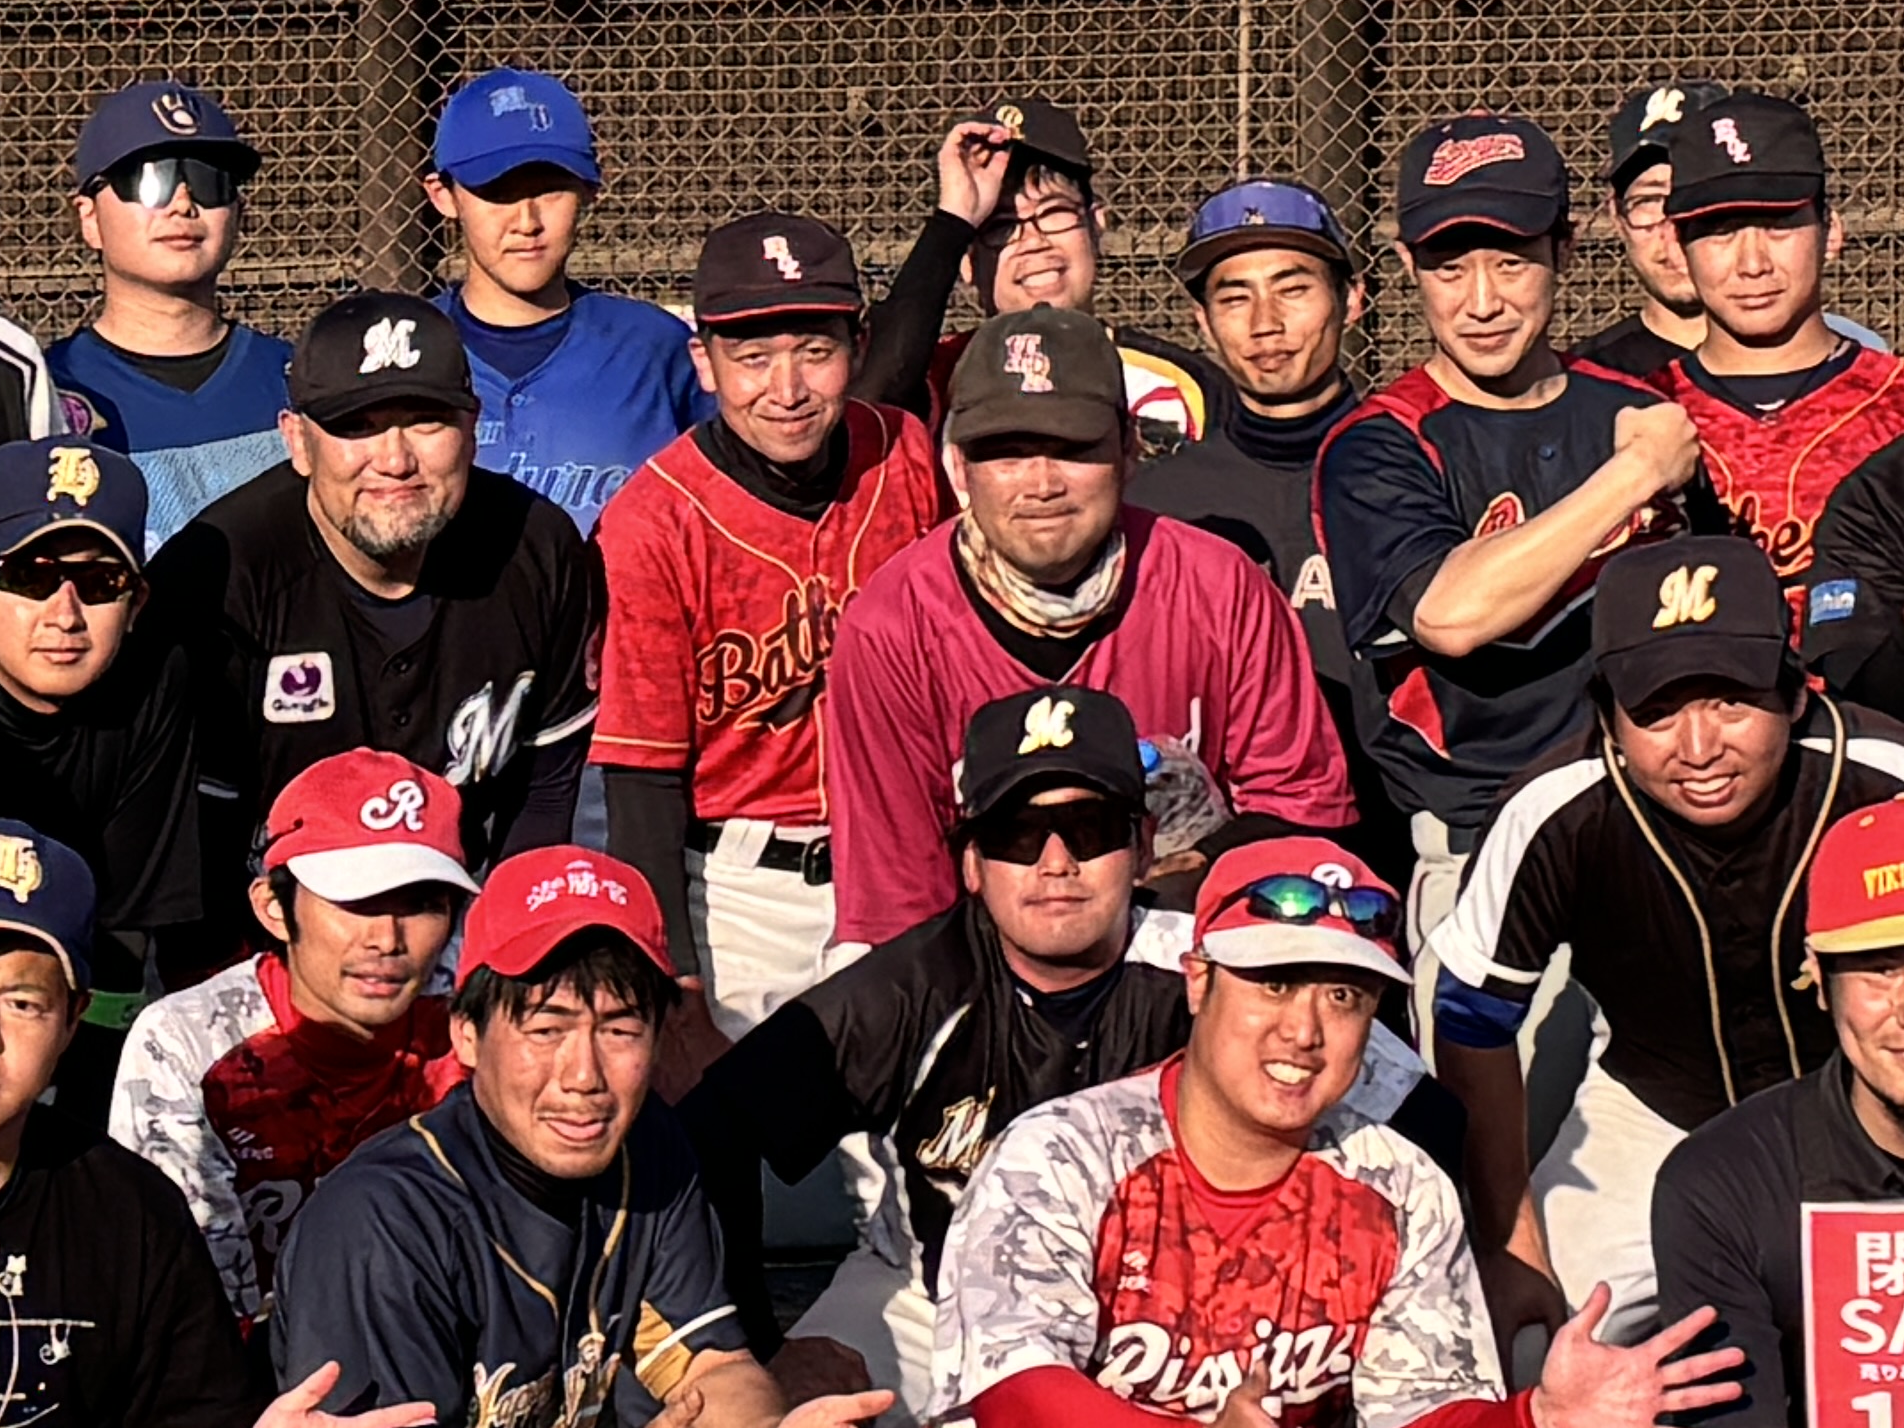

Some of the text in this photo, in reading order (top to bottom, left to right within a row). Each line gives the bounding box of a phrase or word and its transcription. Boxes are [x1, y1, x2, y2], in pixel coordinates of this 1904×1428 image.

[359, 316, 421, 374] M
[1289, 553, 1337, 611] A
[1652, 564, 1719, 630] M
[359, 777, 425, 833] R
